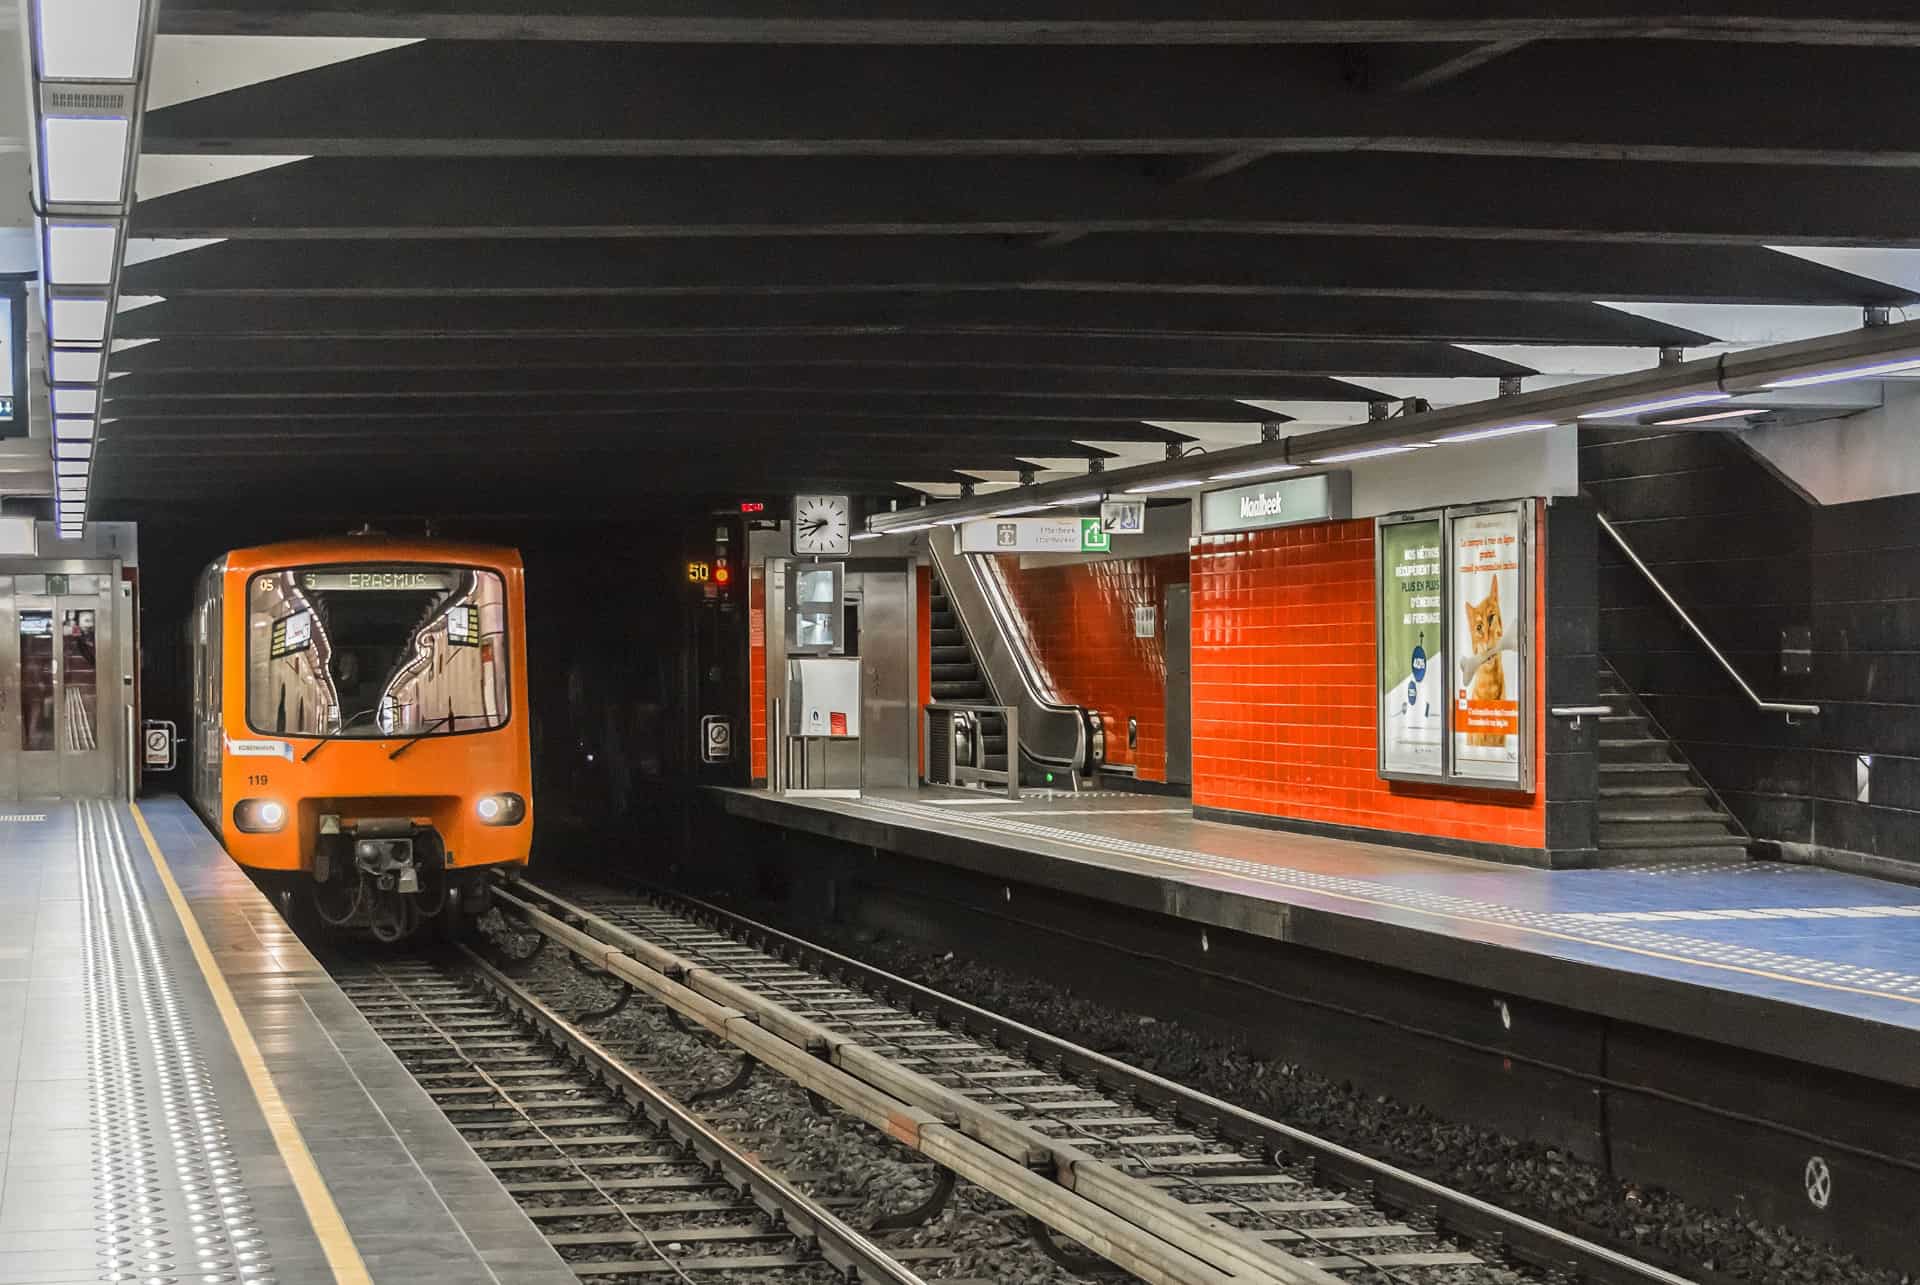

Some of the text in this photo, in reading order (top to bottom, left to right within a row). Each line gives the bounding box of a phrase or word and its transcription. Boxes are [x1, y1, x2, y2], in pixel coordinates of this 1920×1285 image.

[1240, 491, 1281, 518] Maalbeek
[688, 563, 709, 581] 50
[259, 579, 274, 591] 05
[349, 573, 427, 587] ERASMUS
[1401, 580, 1440, 593] PLUS EN PLUS
[247, 775, 269, 785] 119
